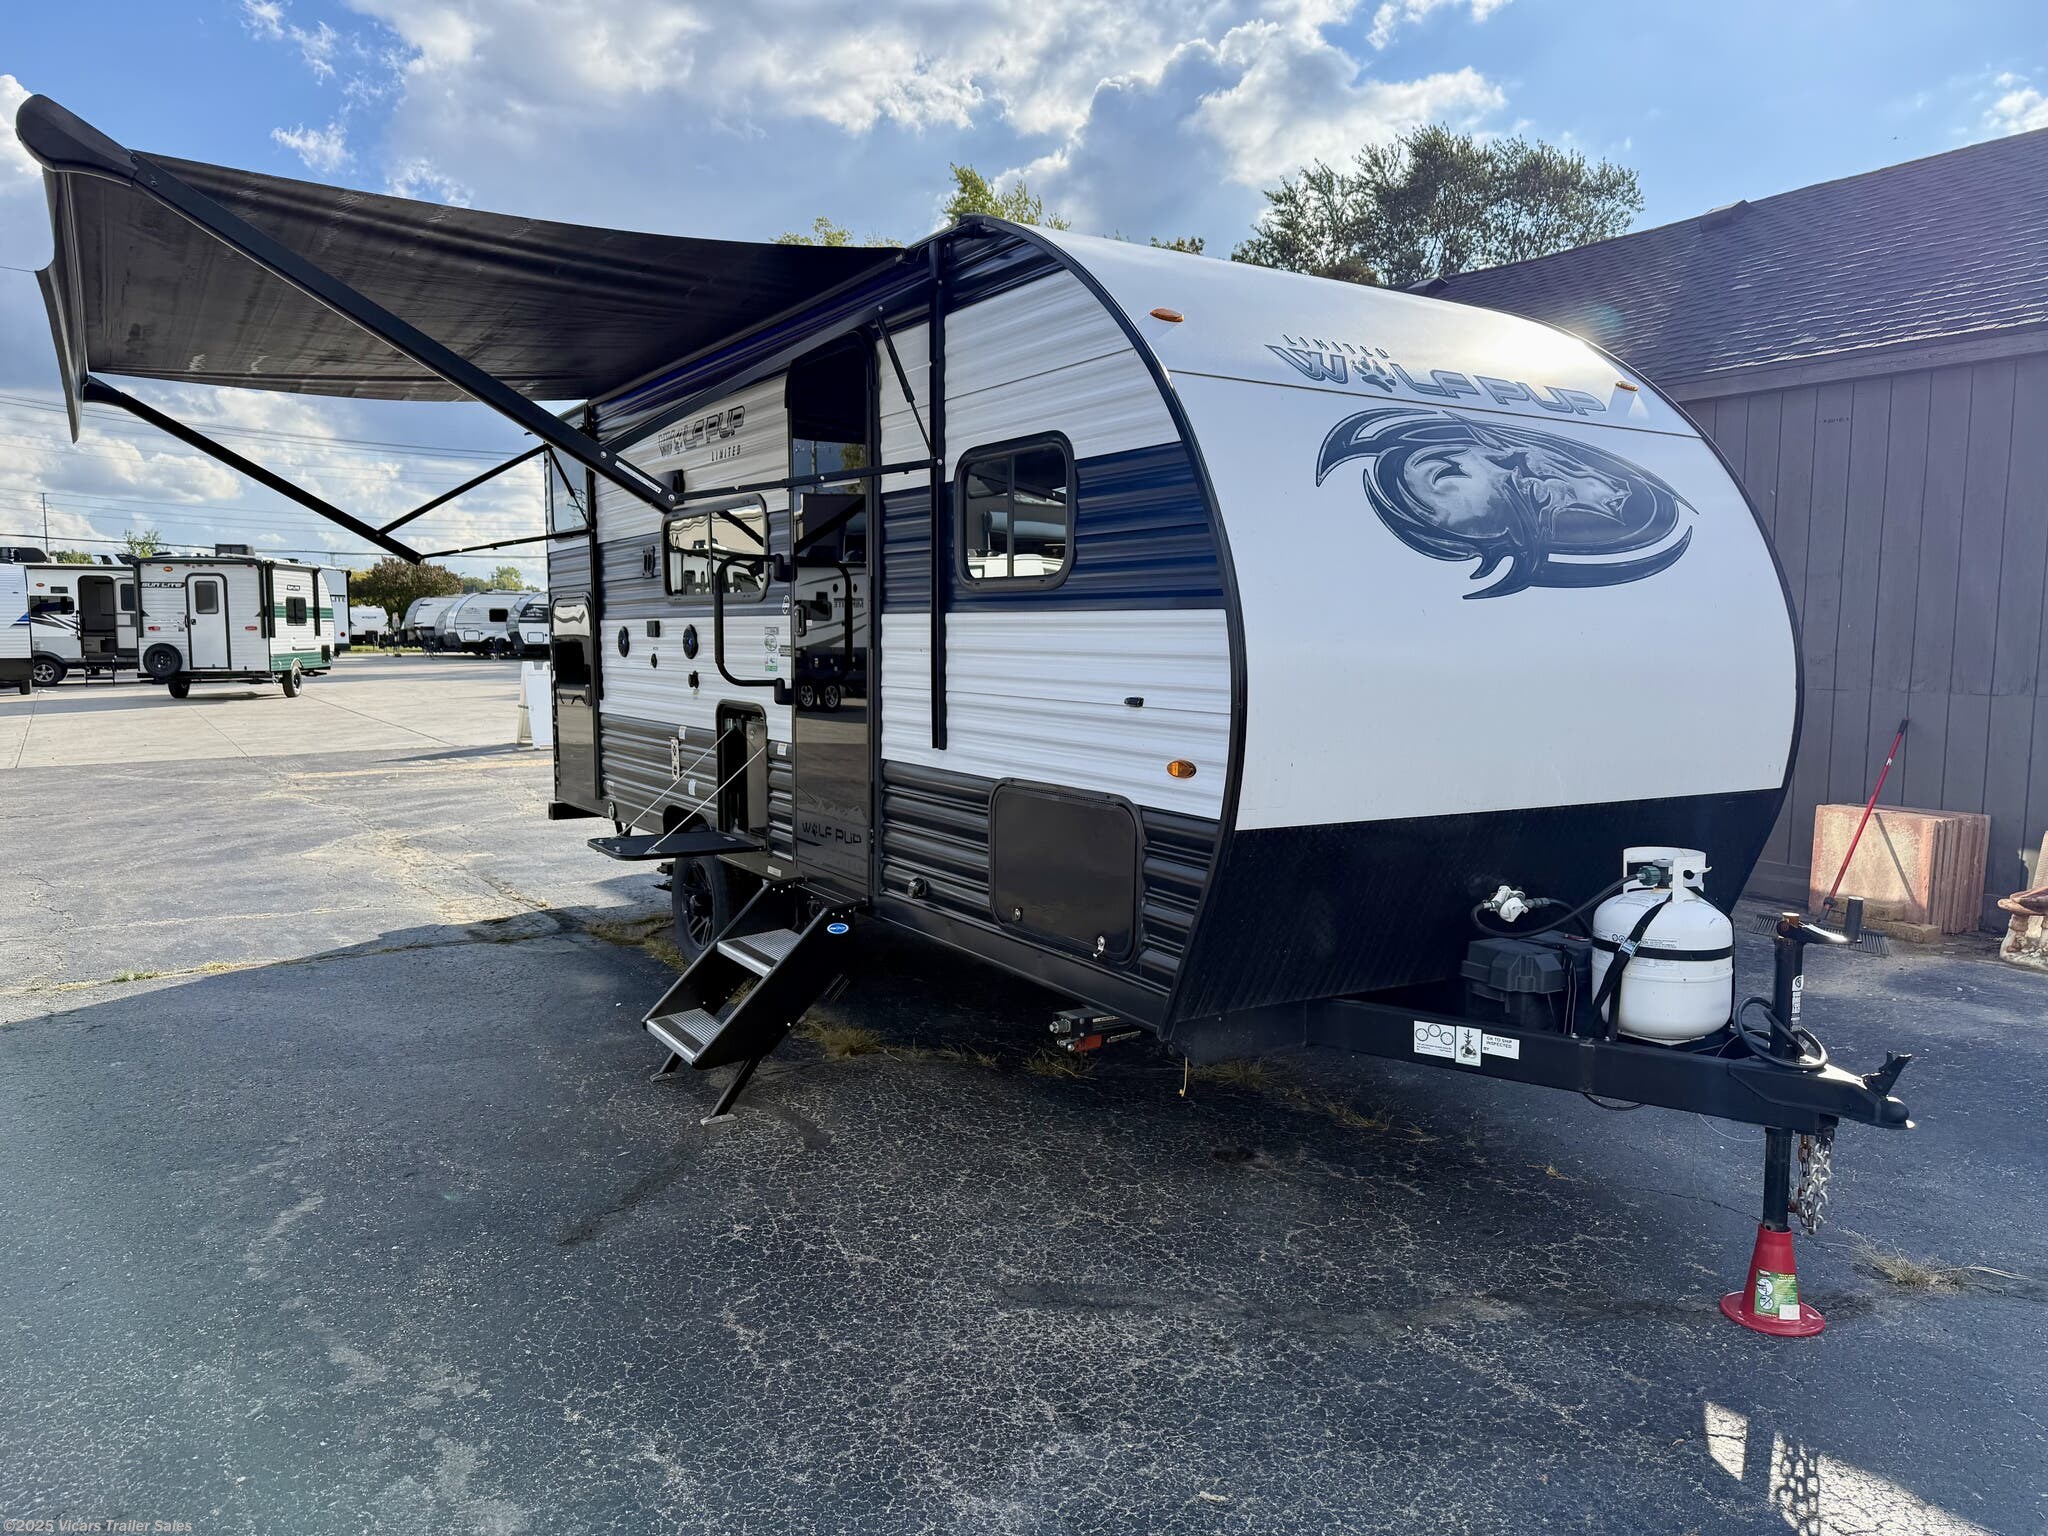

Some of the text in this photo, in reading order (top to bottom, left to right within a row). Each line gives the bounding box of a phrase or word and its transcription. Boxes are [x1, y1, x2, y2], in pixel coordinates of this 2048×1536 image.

[1282, 334, 1390, 359] LIMITED
[1473, 375, 1607, 416] PUP
[706, 405, 745, 444] PUP
[711, 444, 741, 462] LIMITED
[836, 828, 862, 845] PUP
